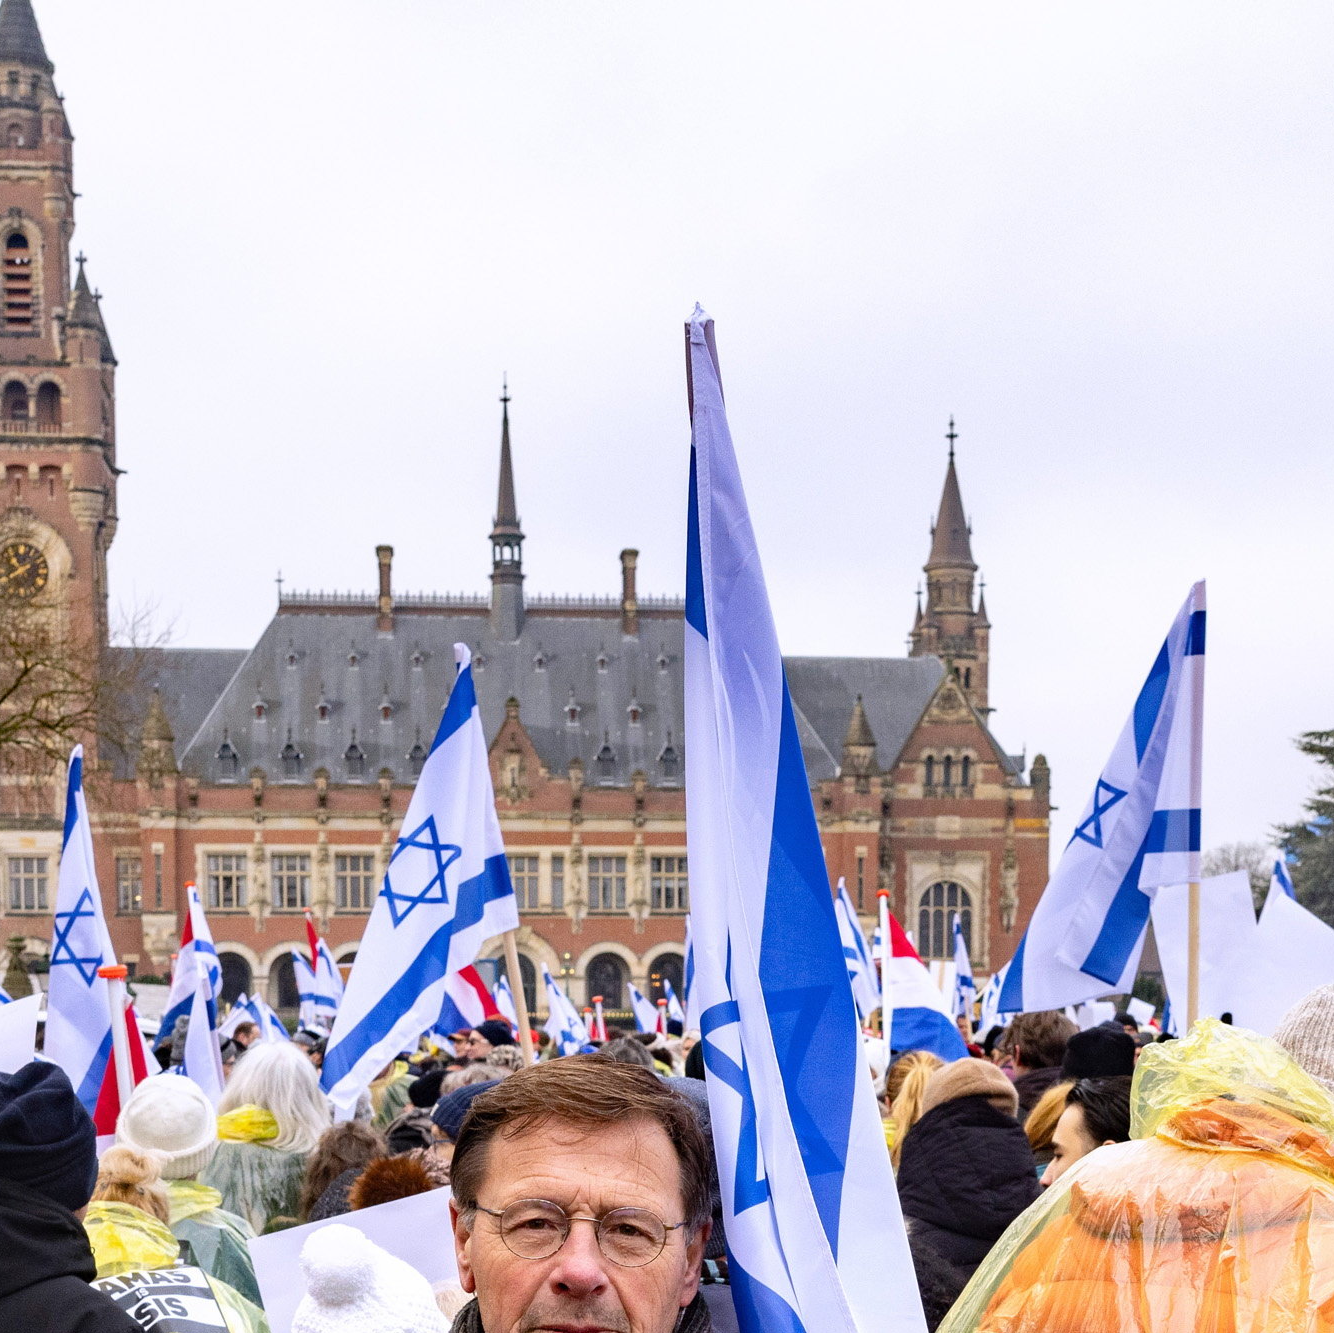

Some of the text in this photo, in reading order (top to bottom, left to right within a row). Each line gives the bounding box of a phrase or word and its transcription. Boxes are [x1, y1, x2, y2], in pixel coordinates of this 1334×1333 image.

[97, 1271, 191, 1295] AMAS
[135, 1288, 149, 1299] IS
[134, 1297, 189, 1327] SIS
